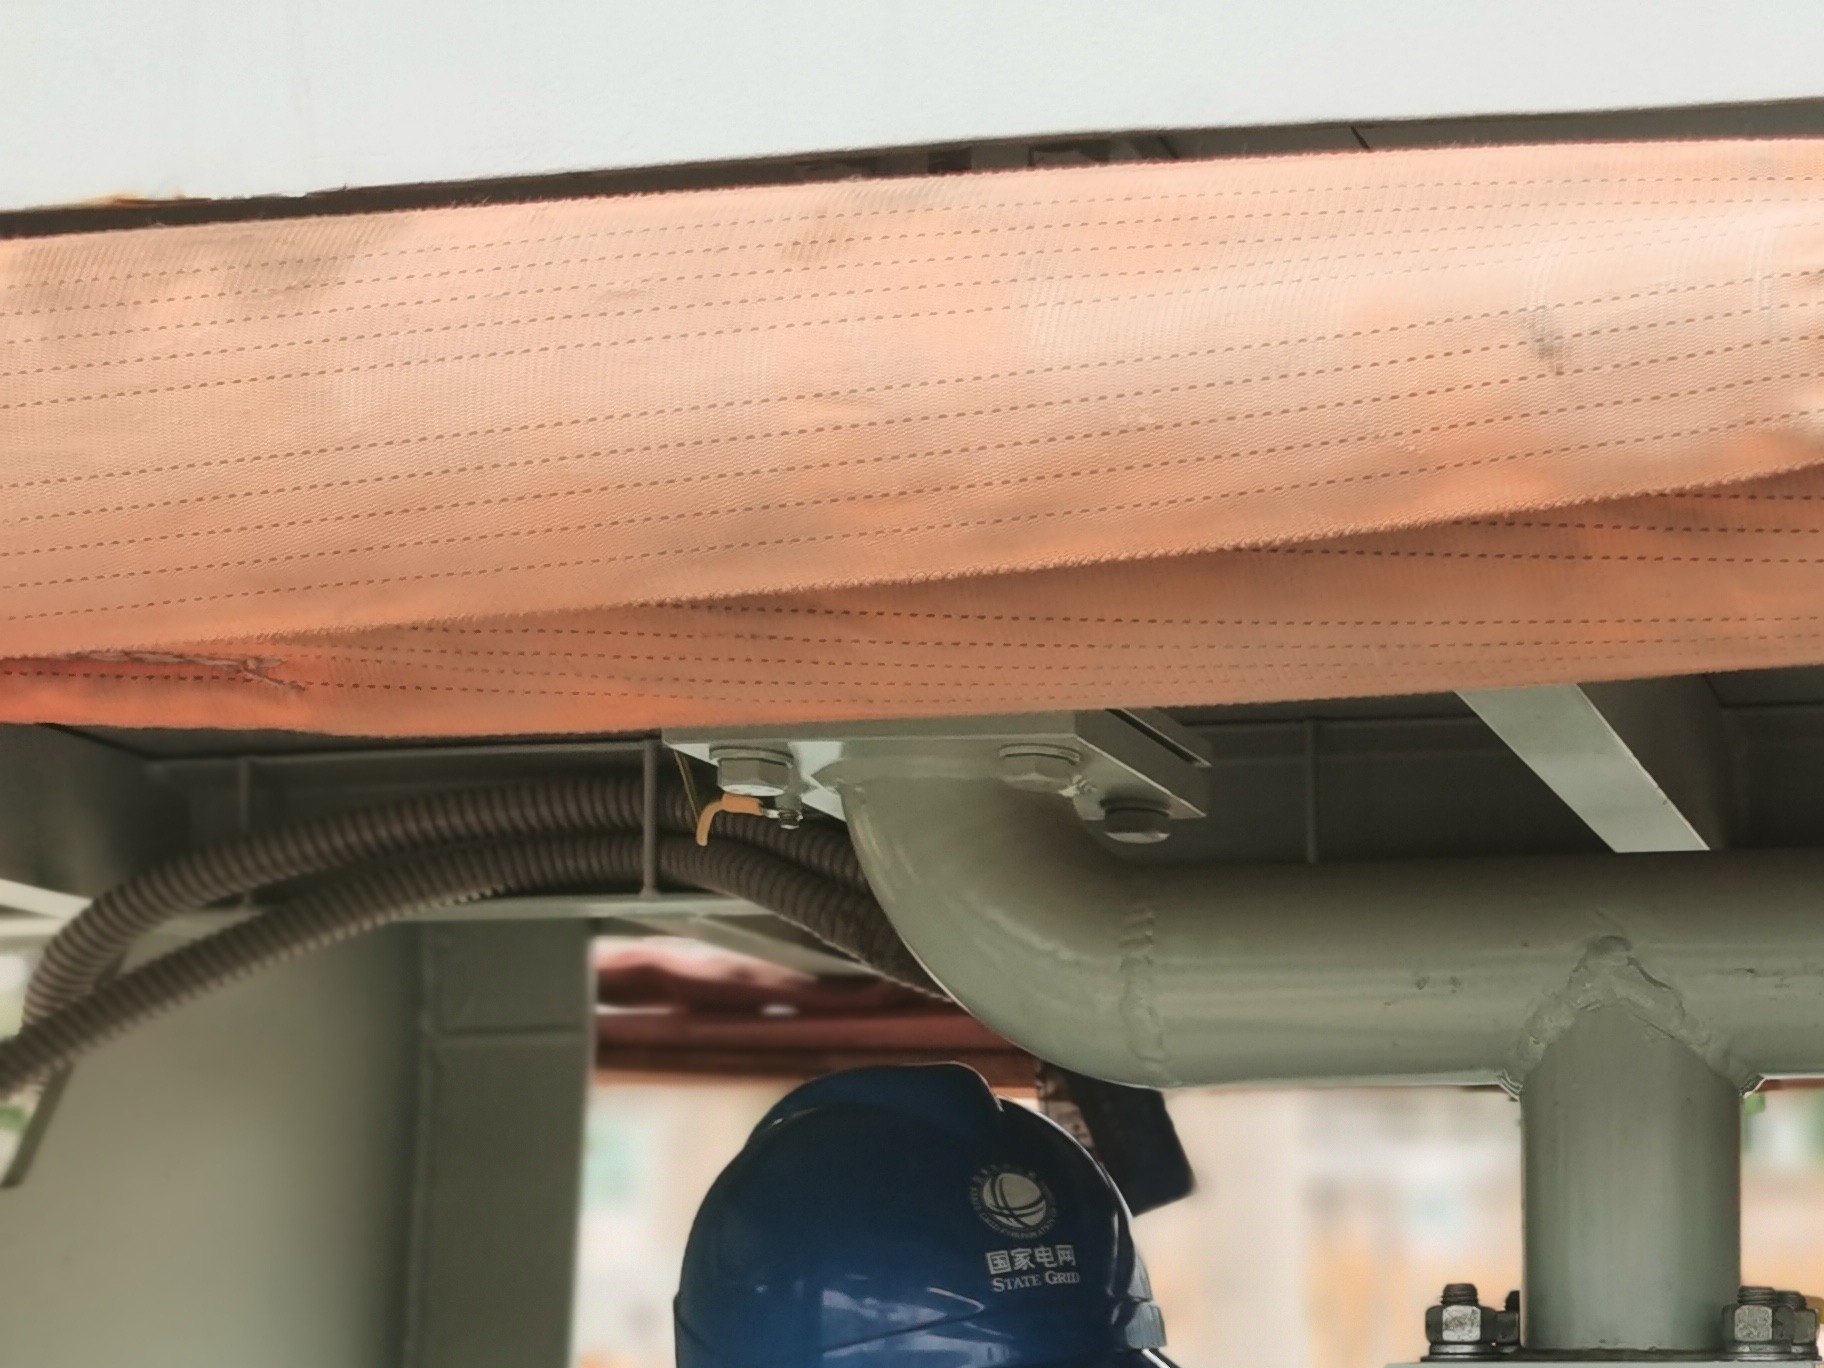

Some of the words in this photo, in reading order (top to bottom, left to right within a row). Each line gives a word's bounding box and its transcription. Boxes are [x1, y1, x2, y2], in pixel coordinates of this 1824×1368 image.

[985, 1244, 1077, 1275] 国家电网
[992, 1274, 1042, 1293] STATE
[1045, 1270, 1080, 1285] GRID
